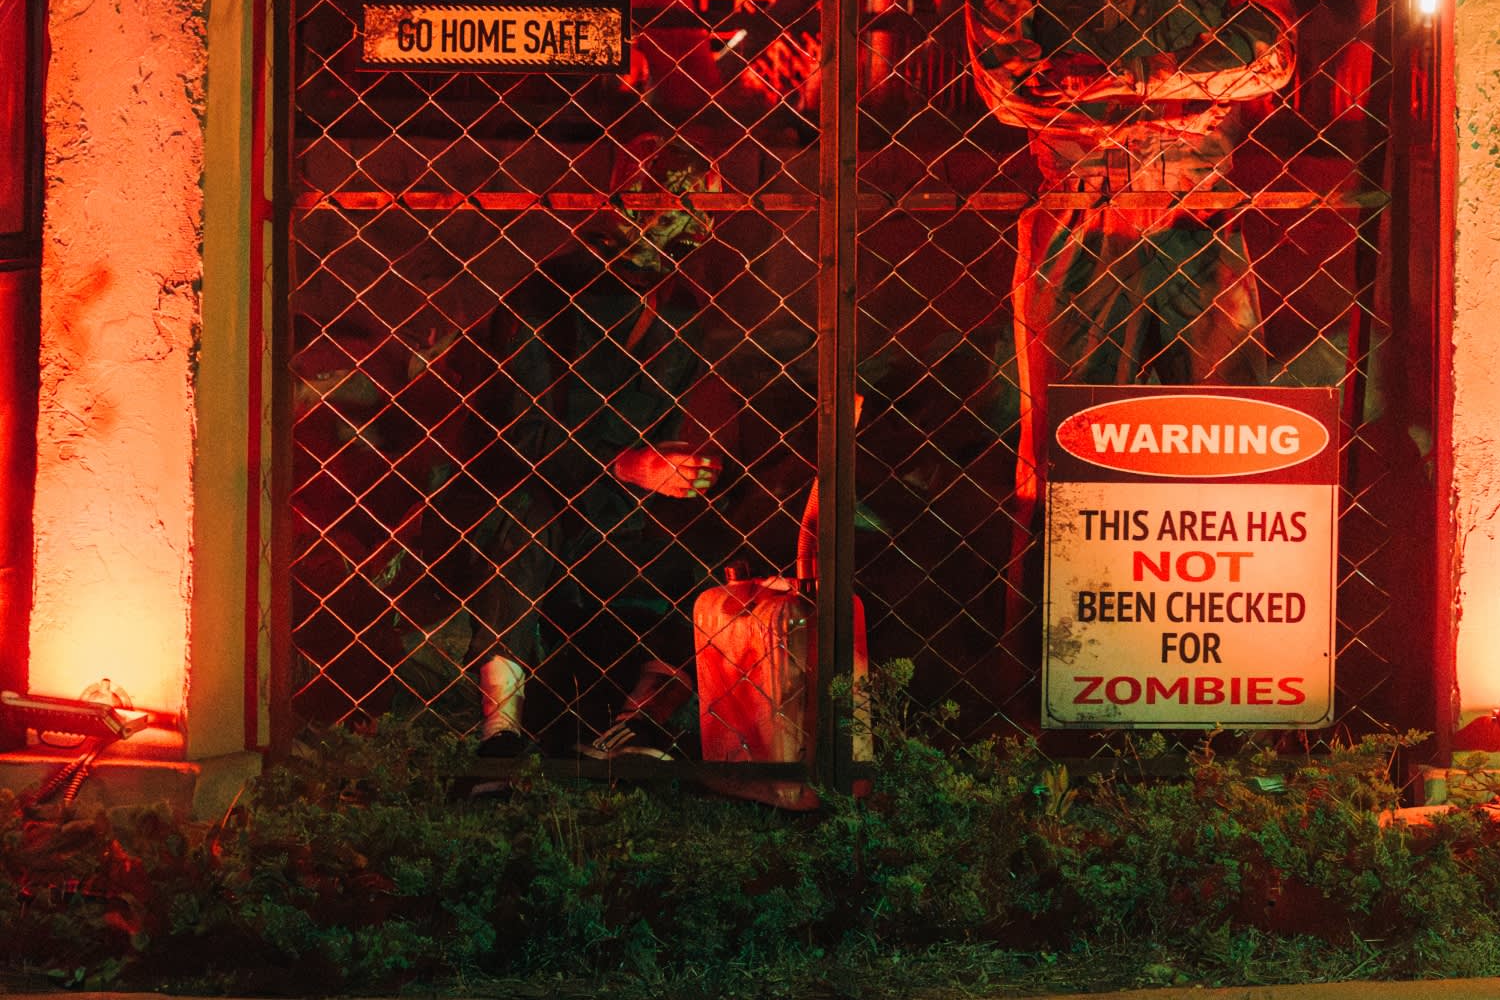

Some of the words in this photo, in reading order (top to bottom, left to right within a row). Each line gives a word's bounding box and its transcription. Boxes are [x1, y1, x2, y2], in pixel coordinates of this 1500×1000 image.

[397, 18, 433, 53] GO
[441, 19, 517, 53] HOME
[523, 20, 590, 54] SAFE
[1091, 423, 1301, 455] WARNING
[1079, 510, 1149, 541] THIS
[1157, 510, 1239, 542] AREA
[1247, 511, 1307, 543] HAS
[1132, 551, 1254, 582] NOT
[1078, 590, 1156, 623] BEEN
[1166, 592, 1306, 624] CHECKED
[1161, 632, 1222, 664] FOR
[1072, 676, 1307, 706] ZOMBIES
